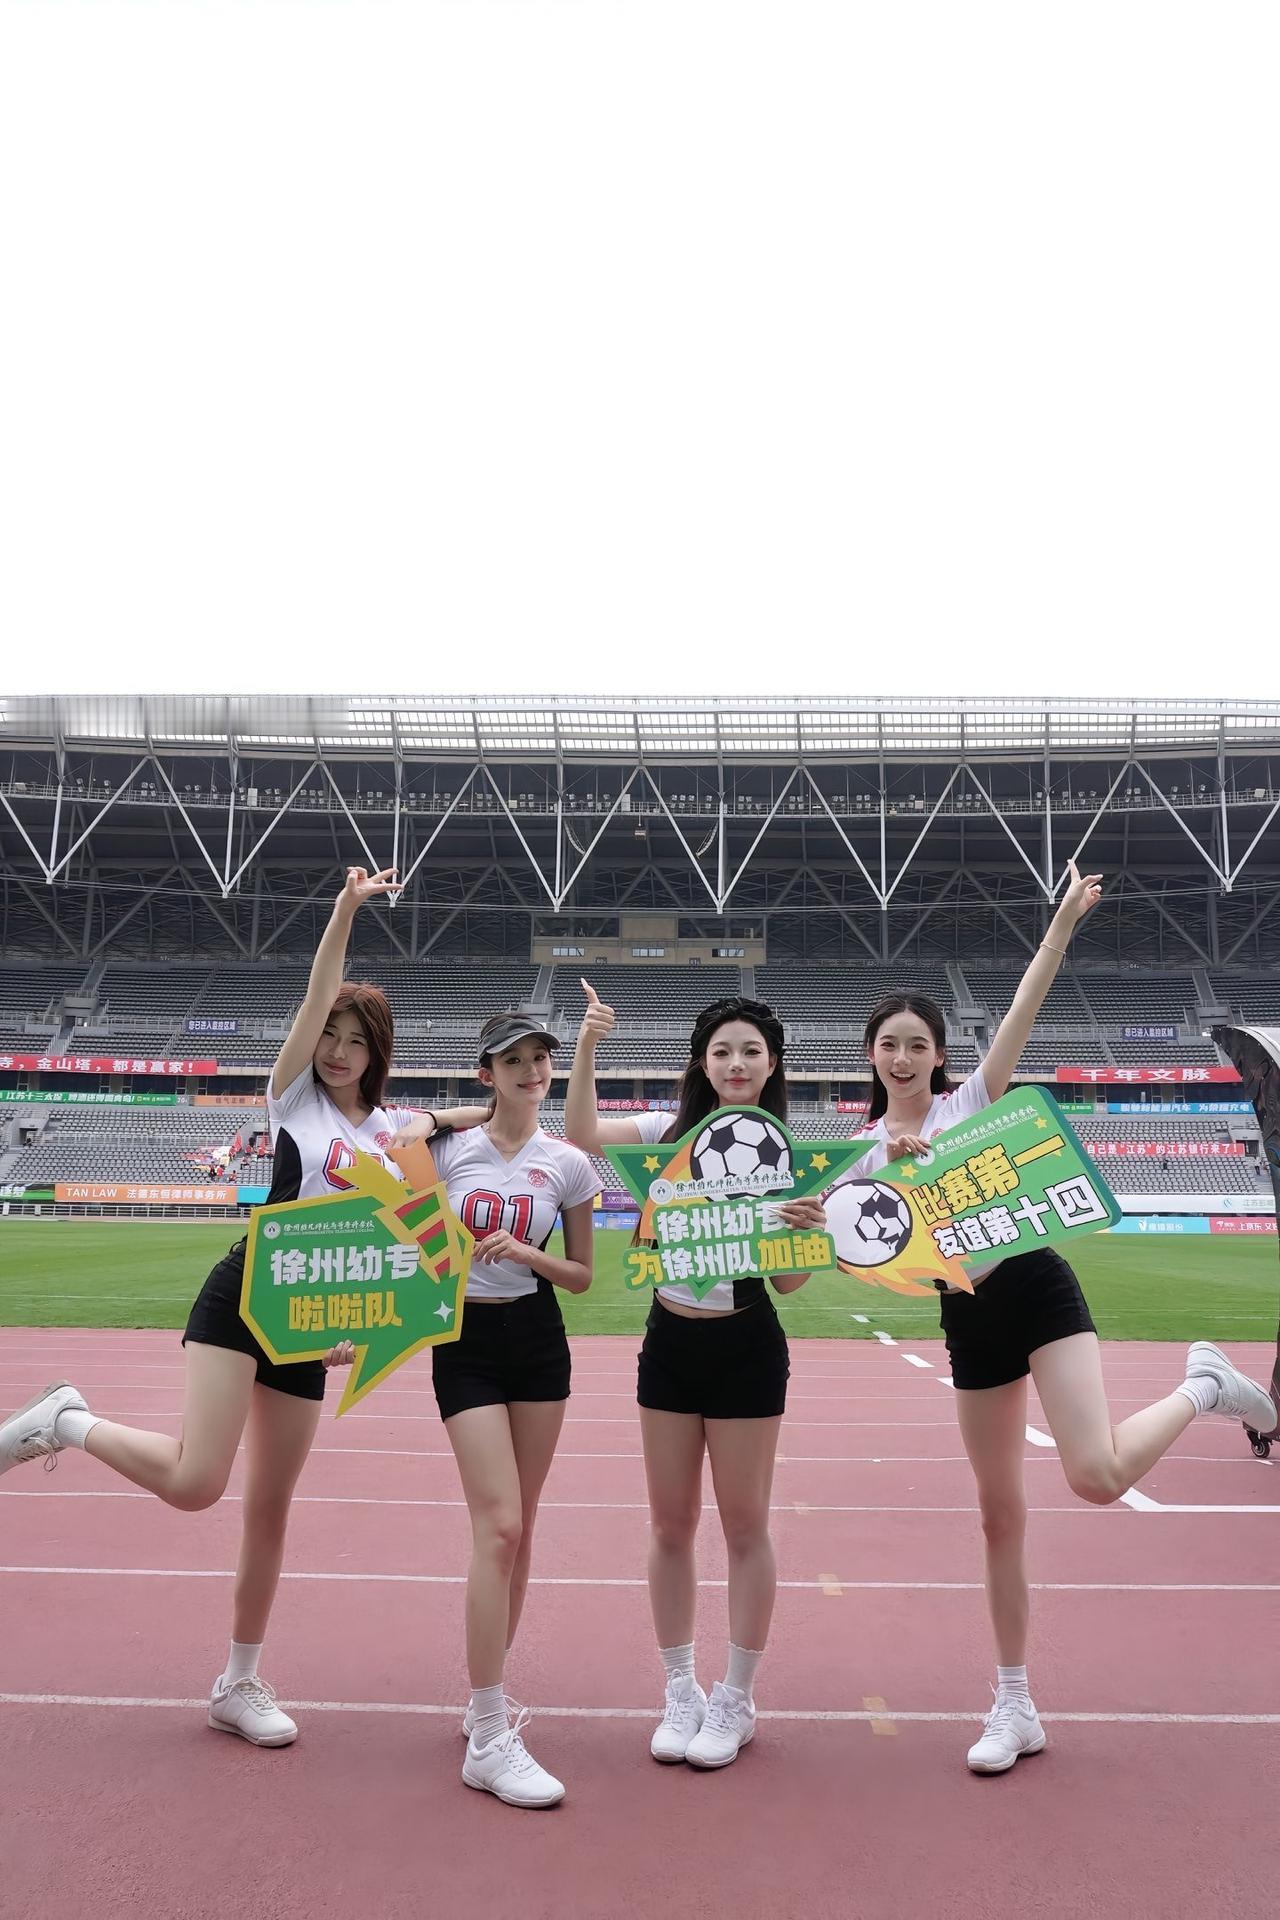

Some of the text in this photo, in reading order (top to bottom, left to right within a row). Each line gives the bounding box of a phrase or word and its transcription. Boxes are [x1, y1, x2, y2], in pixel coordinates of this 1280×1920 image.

[1080, 1068, 1211, 1082] 千年文脉
[66, 1188, 88, 1197] TAN
[93, 1188, 117, 1197] LAW
[910, 1134, 1066, 1226] 比赛第一
[461, 1188, 533, 1245] 01
[932, 1174, 1109, 1259] 友谊第十四
[270, 1243, 420, 1286] 徐州幼专
[628, 1233, 832, 1286] 为徐州队加油
[288, 1291, 402, 1332] 啦啦队
